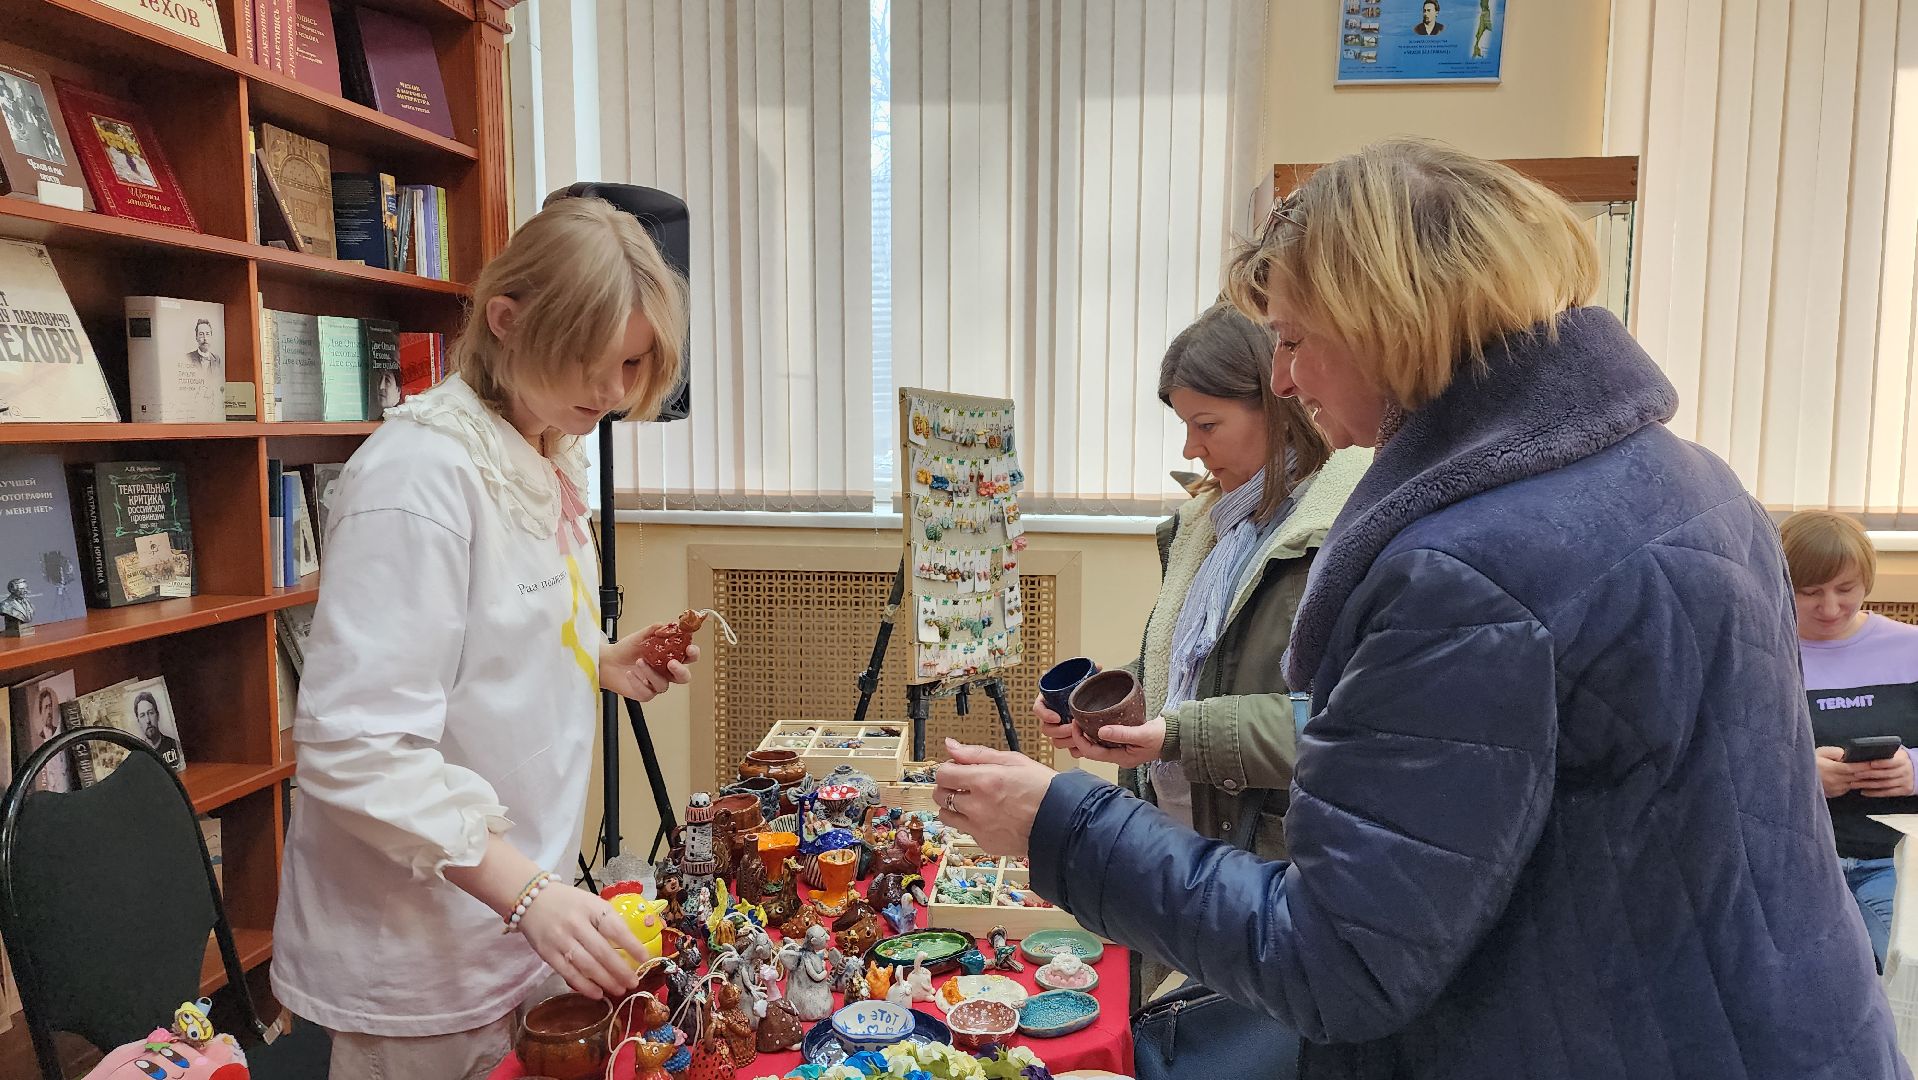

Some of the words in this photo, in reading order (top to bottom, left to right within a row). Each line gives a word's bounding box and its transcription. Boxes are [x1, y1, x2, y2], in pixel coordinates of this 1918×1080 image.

[12, 309, 71, 328] ПАВЛОВИЧУ
[117, 482, 171, 495] ТЕАТРАЛЬНАЯ
[0, 491, 53, 503] ОТОГРАФИИ
[128, 493, 164, 506] КРИТИКА
[5, 505, 34, 516] МЕНЯ
[86, 484, 101, 545] ТЕАТРАЛЬНАЯ
[92, 543, 106, 585] КРИТИКА
[1816, 694, 1875, 711] TERMIT
